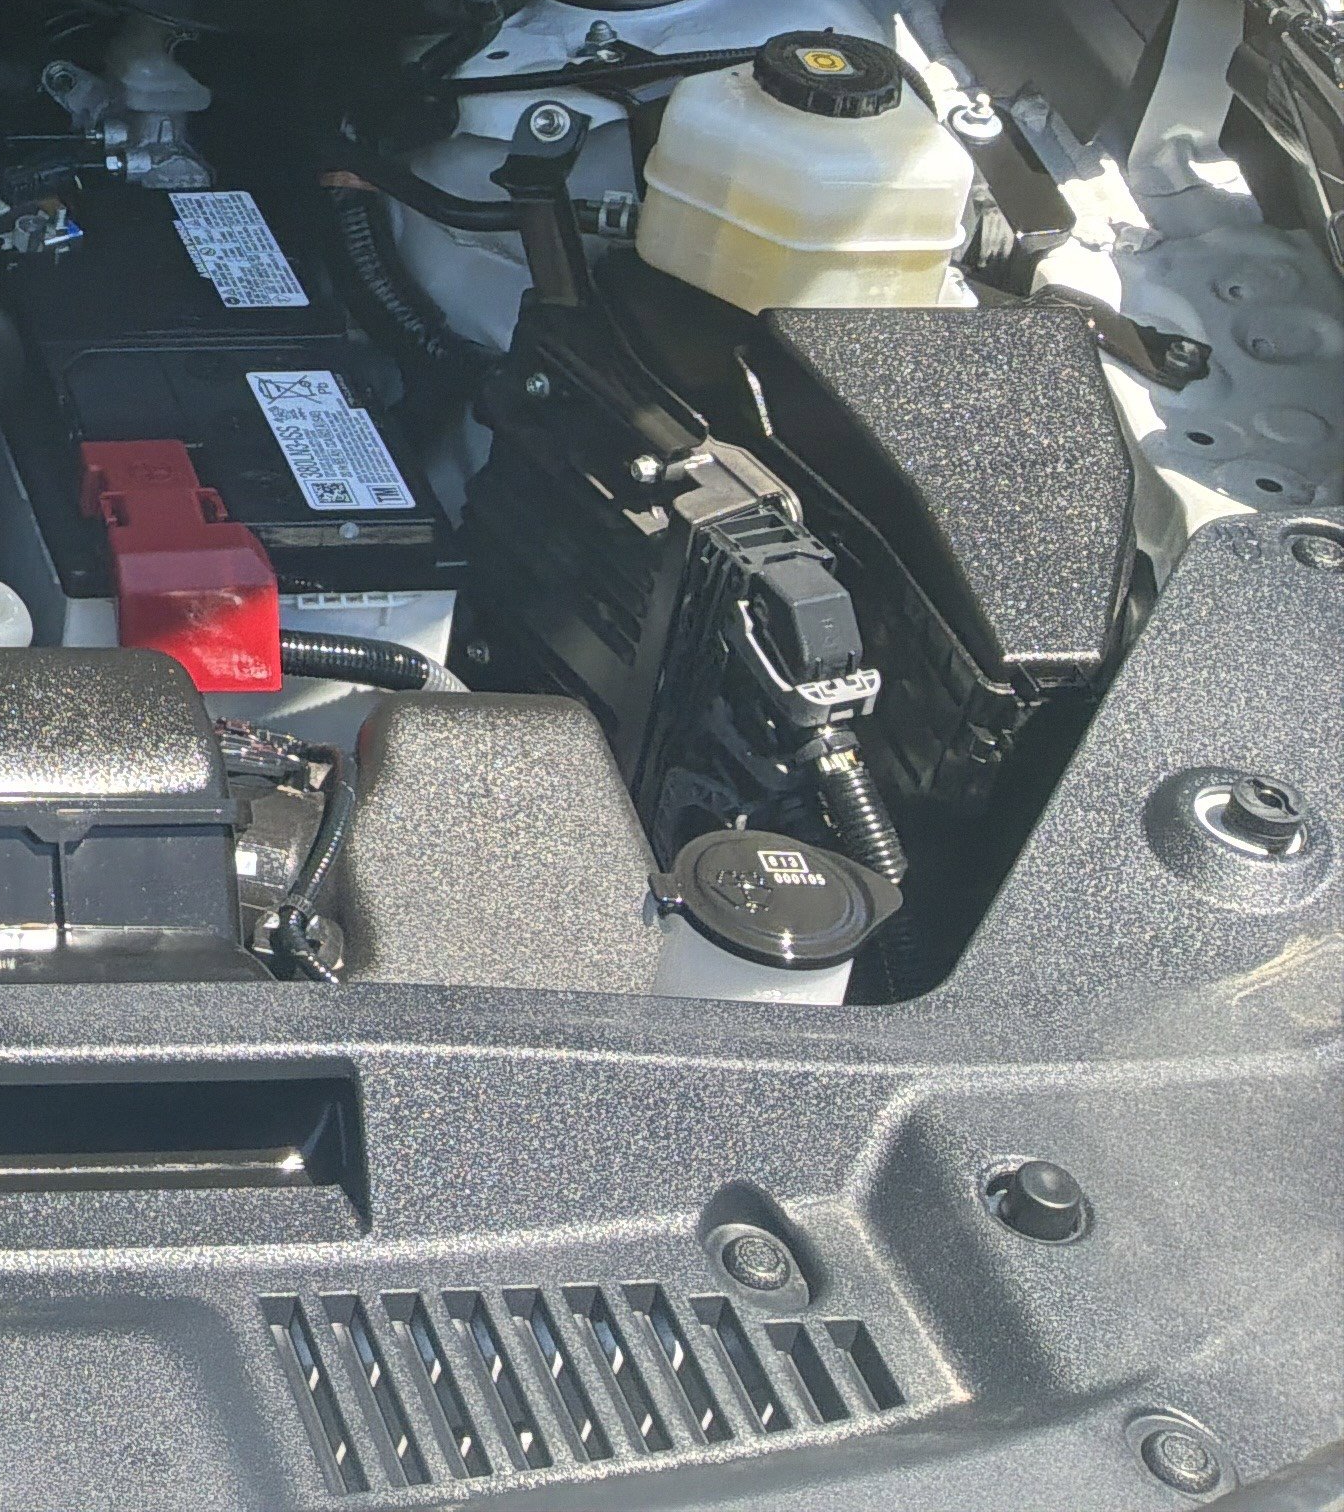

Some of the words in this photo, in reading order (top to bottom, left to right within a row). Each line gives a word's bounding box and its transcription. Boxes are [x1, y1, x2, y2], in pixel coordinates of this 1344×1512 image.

[318, 382, 333, 395] Pb
[372, 487, 403, 503] TM
[773, 872, 826, 886] 000105
